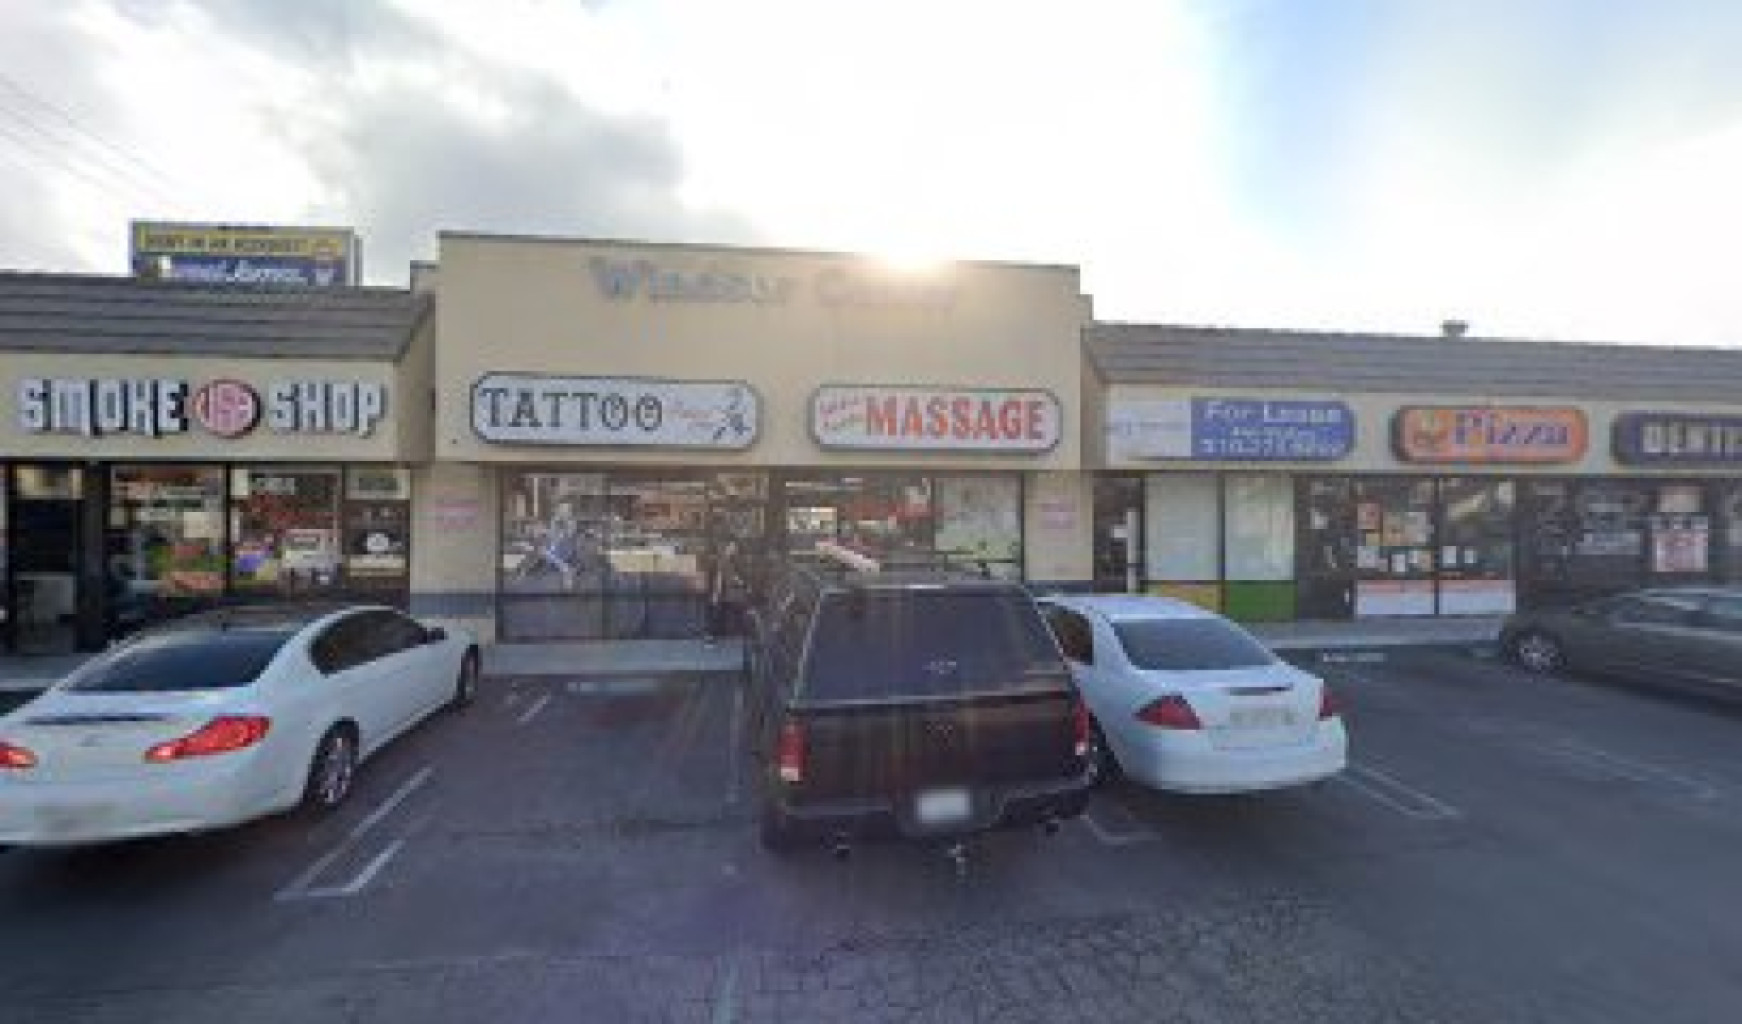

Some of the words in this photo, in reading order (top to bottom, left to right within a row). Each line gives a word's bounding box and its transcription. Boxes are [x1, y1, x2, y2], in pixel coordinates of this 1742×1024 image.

[20, 378, 187, 437] SMOKE
[269, 380, 384, 437] SHOP
[480, 387, 662, 432] TATTOO
[866, 396, 1043, 439] MASSAGE
[1454, 408, 1568, 445] Pizza
